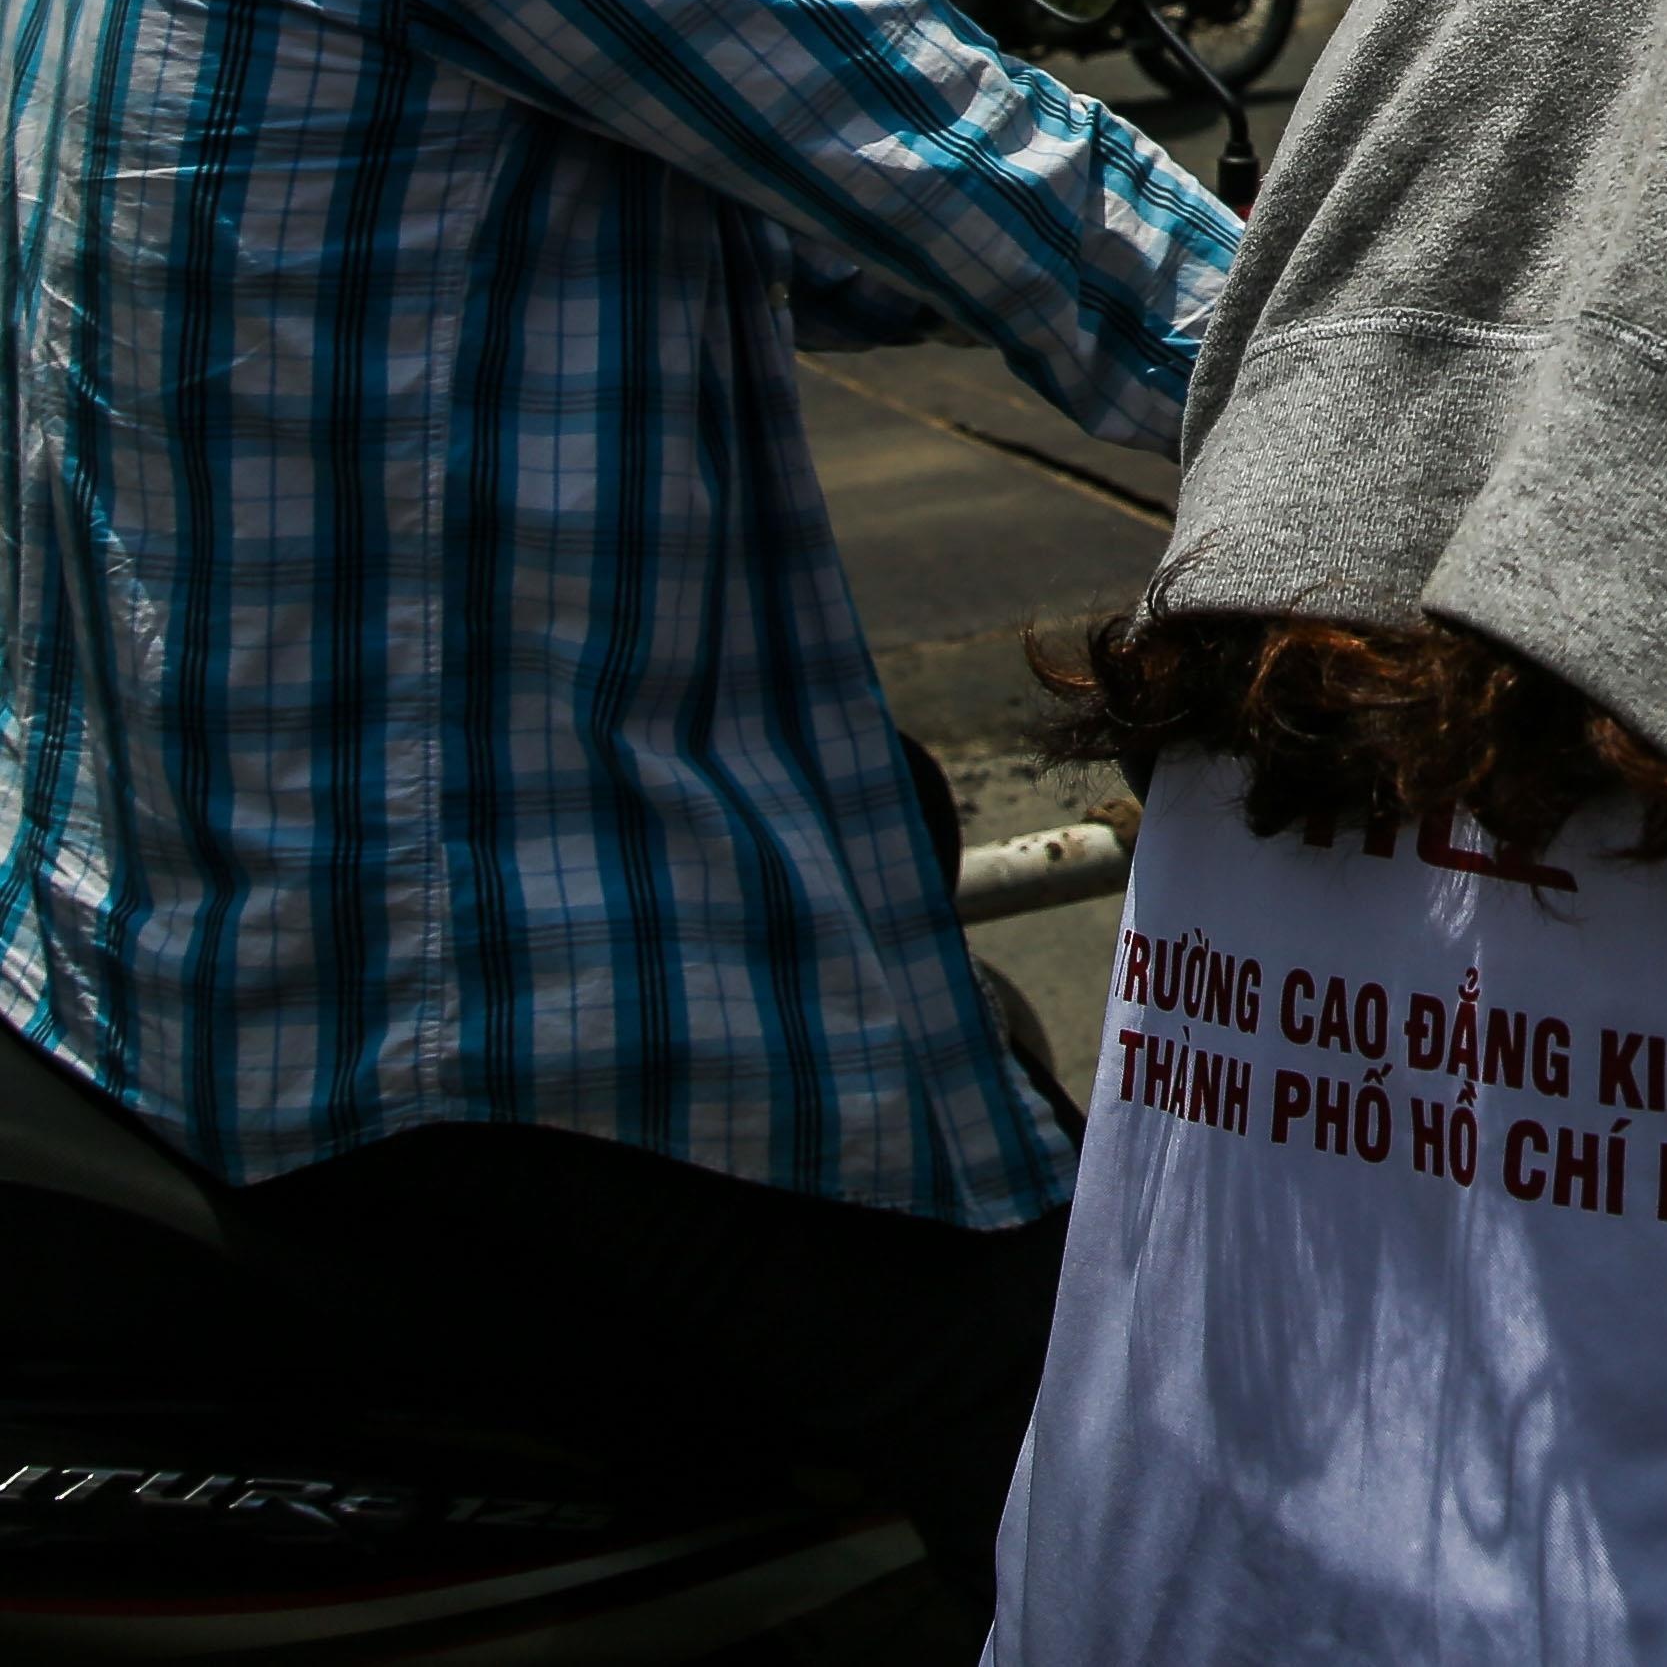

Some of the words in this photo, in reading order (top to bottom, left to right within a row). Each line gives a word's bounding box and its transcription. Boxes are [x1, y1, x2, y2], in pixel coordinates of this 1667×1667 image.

[1280, 967, 1389, 1061] CAO
[1403, 965, 1571, 1099] ĐẲNG
[1118, 1025, 1252, 1136] THÀNH
[1270, 1062, 1394, 1163] PHỐ
[1410, 1079, 1478, 1189] HỒ
[1503, 1116, 1632, 1216] CHÍ
[444, 1493, 618, 1530] 125
